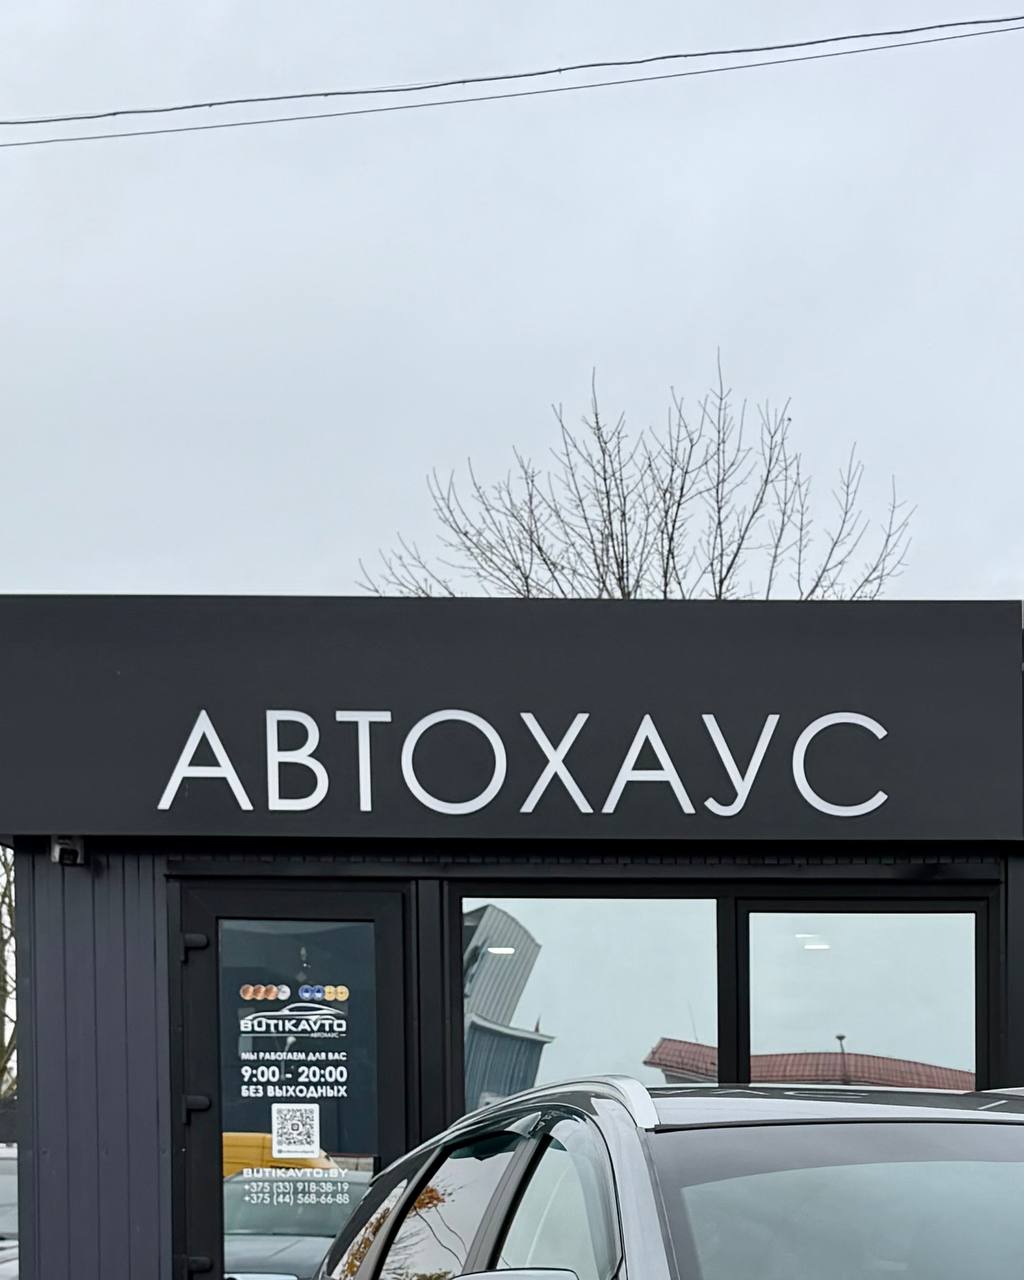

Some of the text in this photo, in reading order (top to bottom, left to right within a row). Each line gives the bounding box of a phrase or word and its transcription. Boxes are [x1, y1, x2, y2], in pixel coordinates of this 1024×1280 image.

[156, 708, 889, 818] АВТОХАУС
[240, 1020, 346, 1032] BUTIKAVTO
[241, 1052, 347, 1061] МЫ РАБОТАЕМ ДЛЯ ВАС
[241, 1066, 280, 1082] 9:00
[298, 1066, 347, 1082] 20:00
[241, 1086, 347, 1098] БЕЗ ВЫХОДНЫХ
[242, 1168, 348, 1177] BUTIKAVTO.BY
[244, 1182, 348, 1194] +375 (33) 918-38-19
[244, 1193, 349, 1205] +375 (44) 568-66-88
